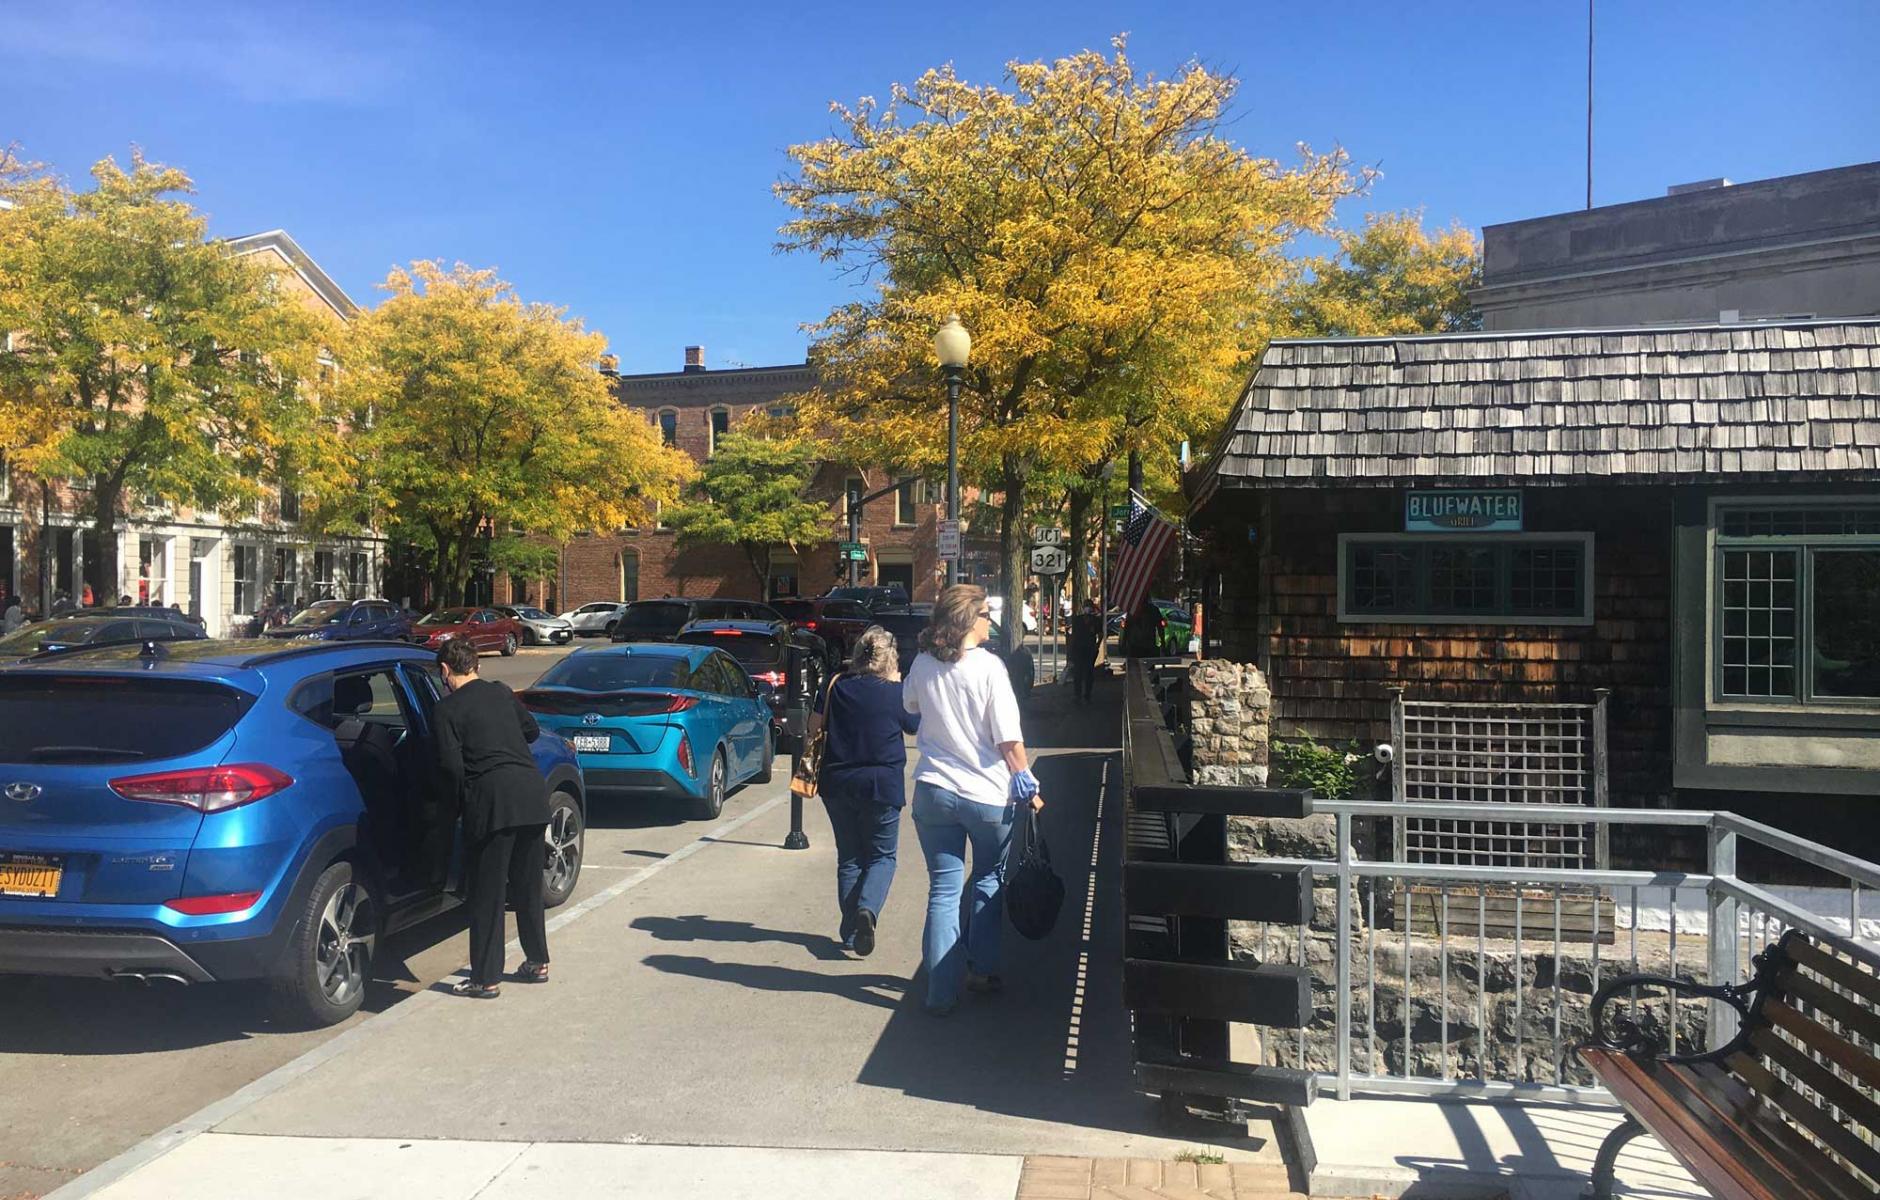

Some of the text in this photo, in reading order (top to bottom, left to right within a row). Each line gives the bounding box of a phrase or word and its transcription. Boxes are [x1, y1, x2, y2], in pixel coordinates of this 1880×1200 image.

[1409, 495, 1518, 517] BLUEWATER
[1037, 529, 1060, 543] JCT
[1035, 553, 1061, 568] 321
